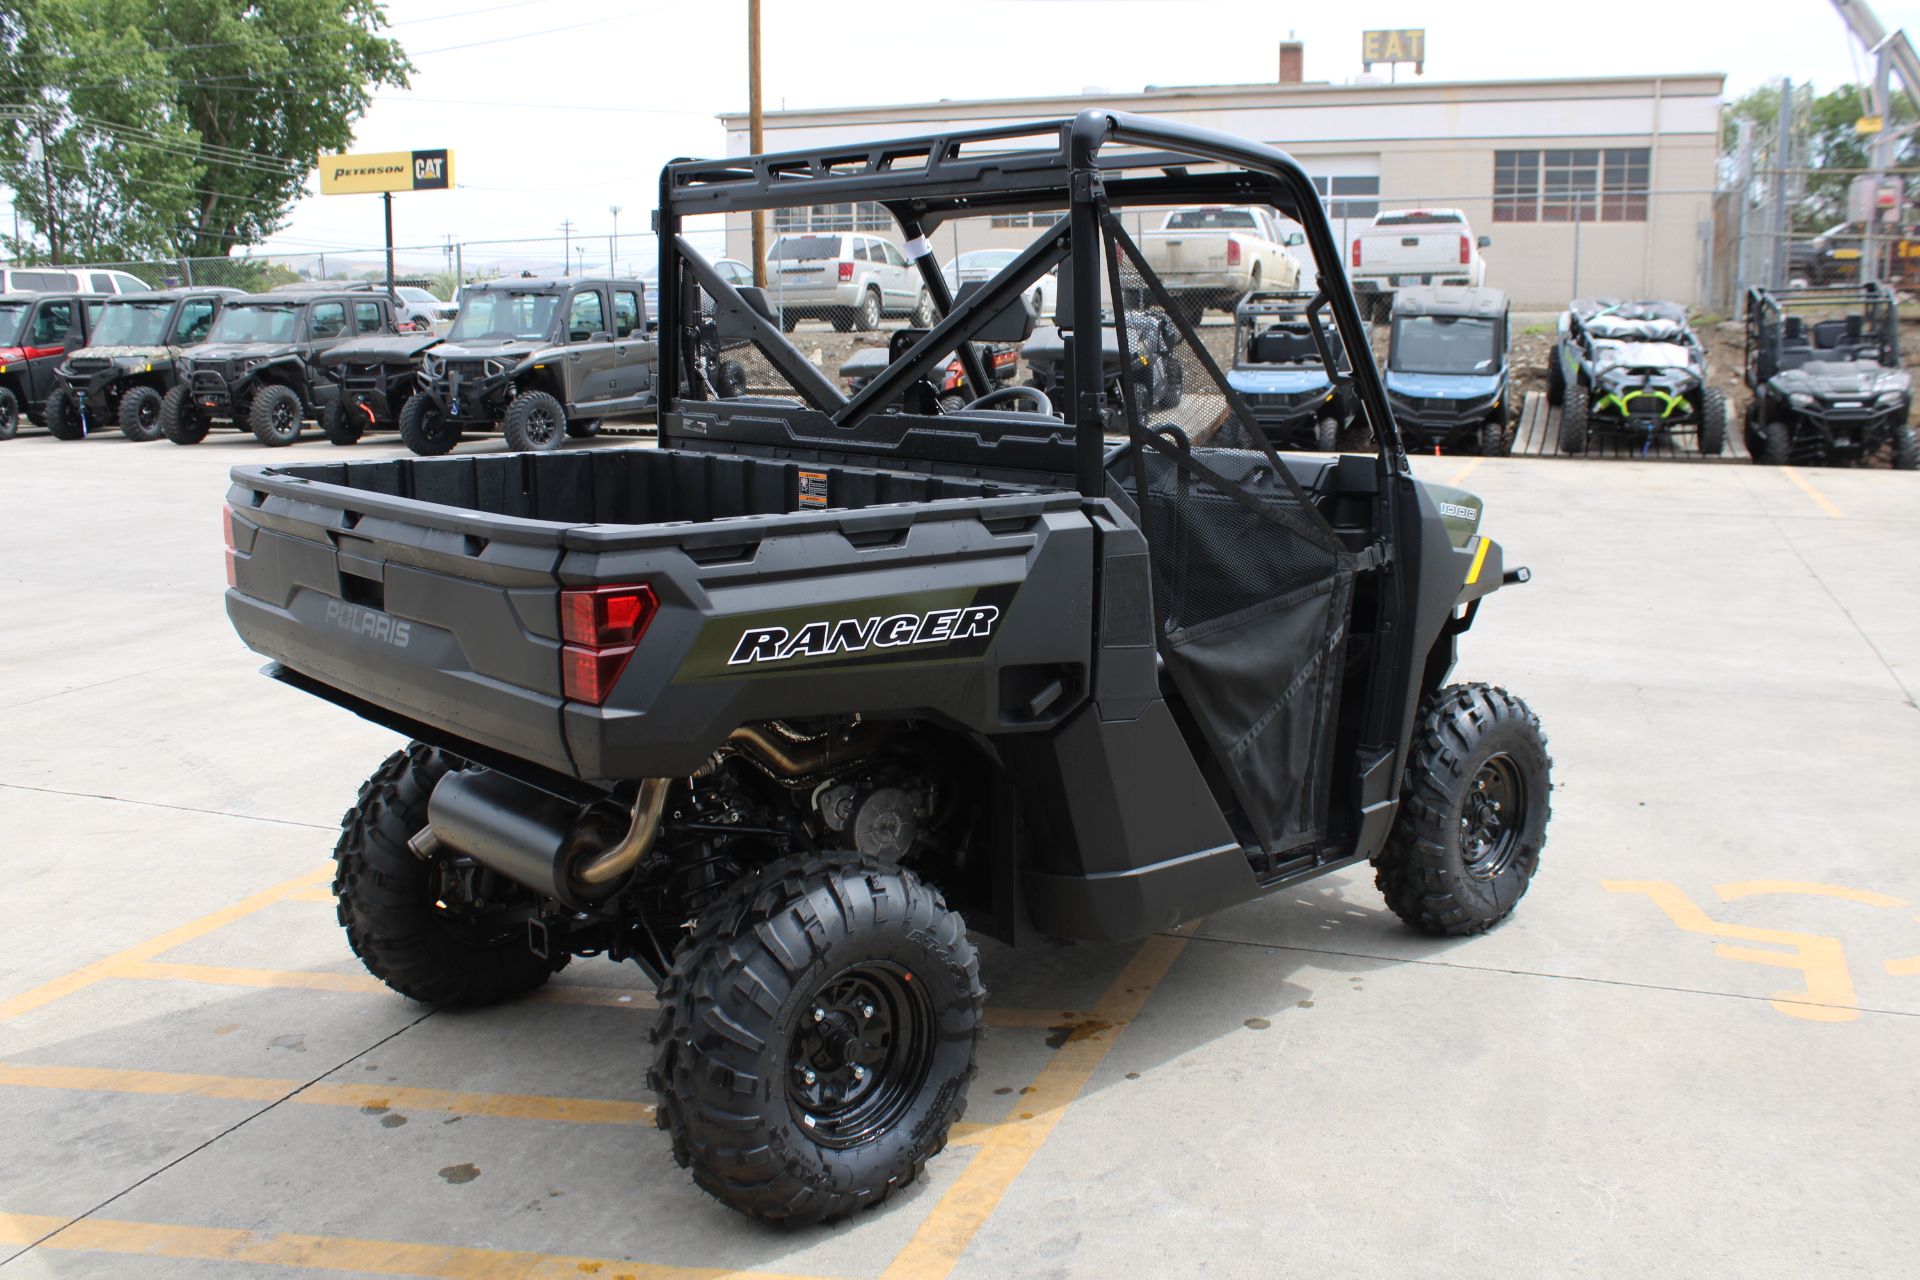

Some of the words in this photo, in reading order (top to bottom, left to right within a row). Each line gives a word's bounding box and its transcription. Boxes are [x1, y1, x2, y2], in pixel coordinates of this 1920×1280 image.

[1365, 30, 1424, 59] EAT
[334, 166, 404, 181] PETERSON
[415, 158, 443, 180] CAT
[1440, 502, 1477, 521] 1000
[325, 600, 411, 648] POLARIS
[727, 605, 999, 665] RANGER
